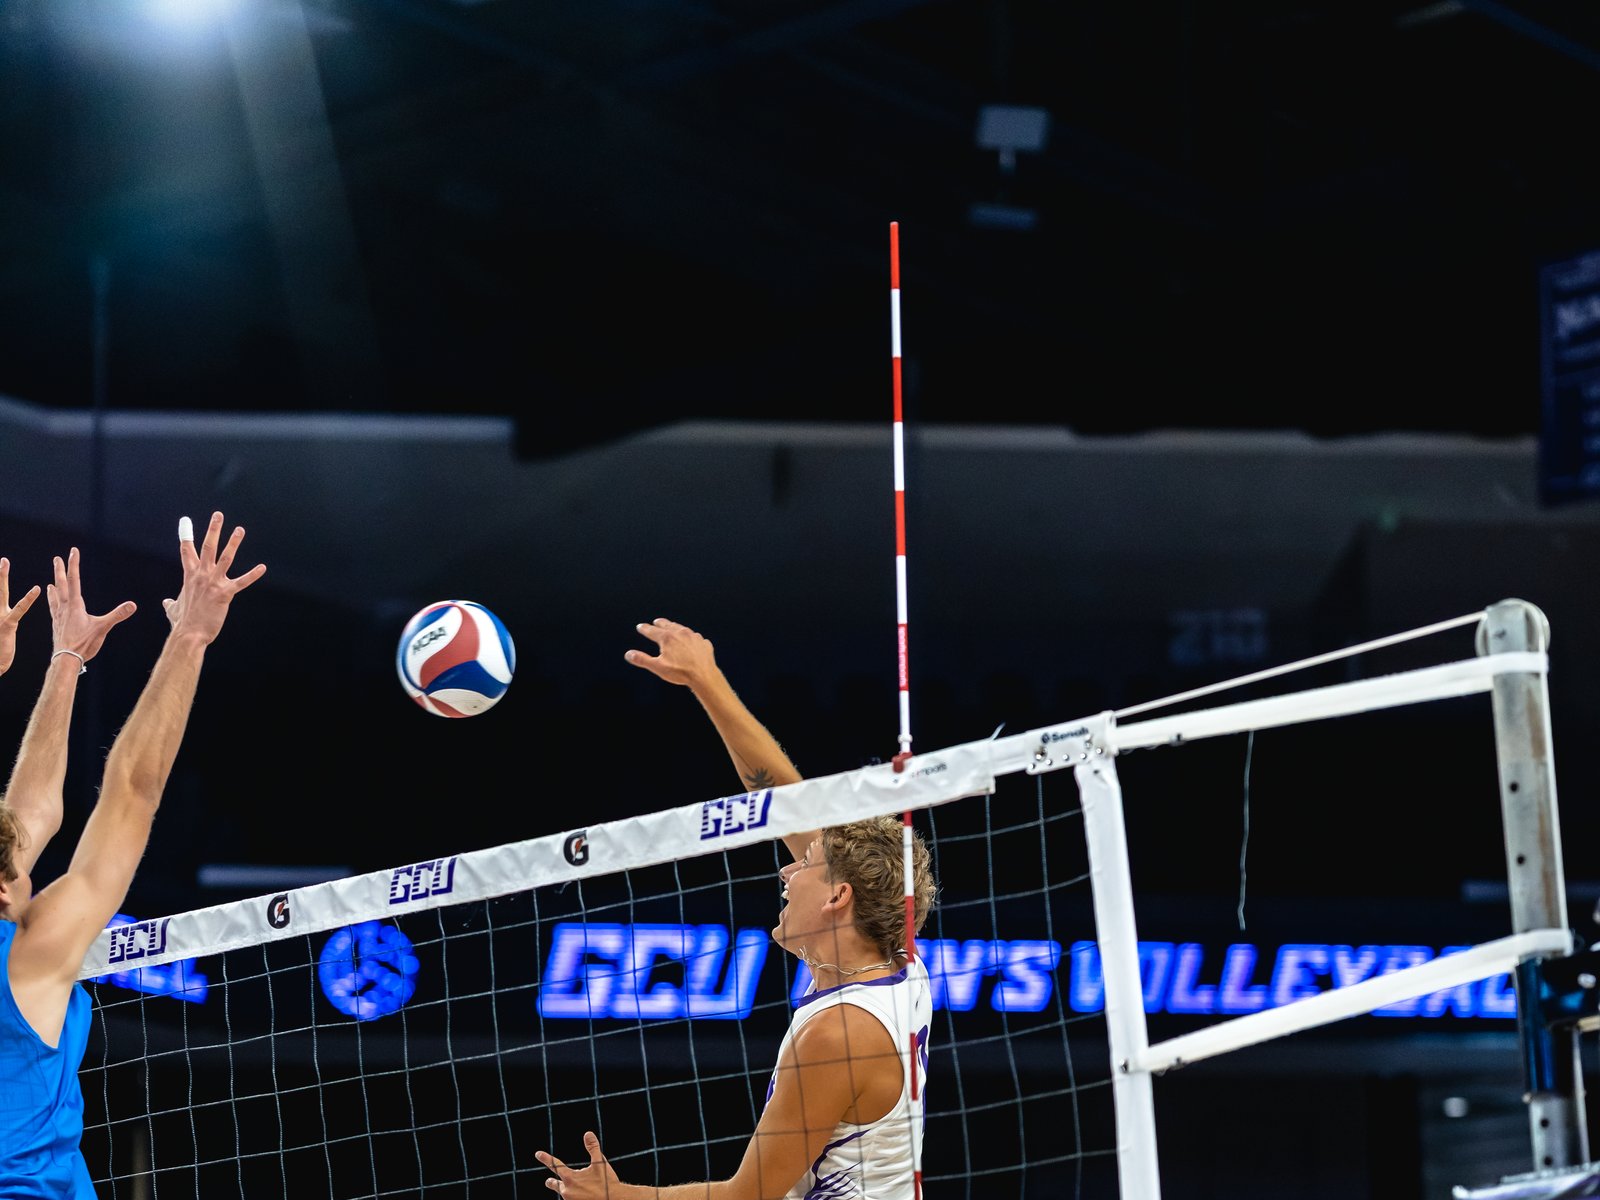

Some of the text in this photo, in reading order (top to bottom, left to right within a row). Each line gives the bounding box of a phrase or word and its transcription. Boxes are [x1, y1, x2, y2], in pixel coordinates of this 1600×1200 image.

[413, 626, 447, 655] NCAA
[700, 789, 773, 840] GCU
[563, 830, 590, 867] G
[389, 857, 458, 905] GCU
[267, 894, 291, 930] G
[108, 917, 172, 964] GCU
[537, 923, 768, 1019] GCU
